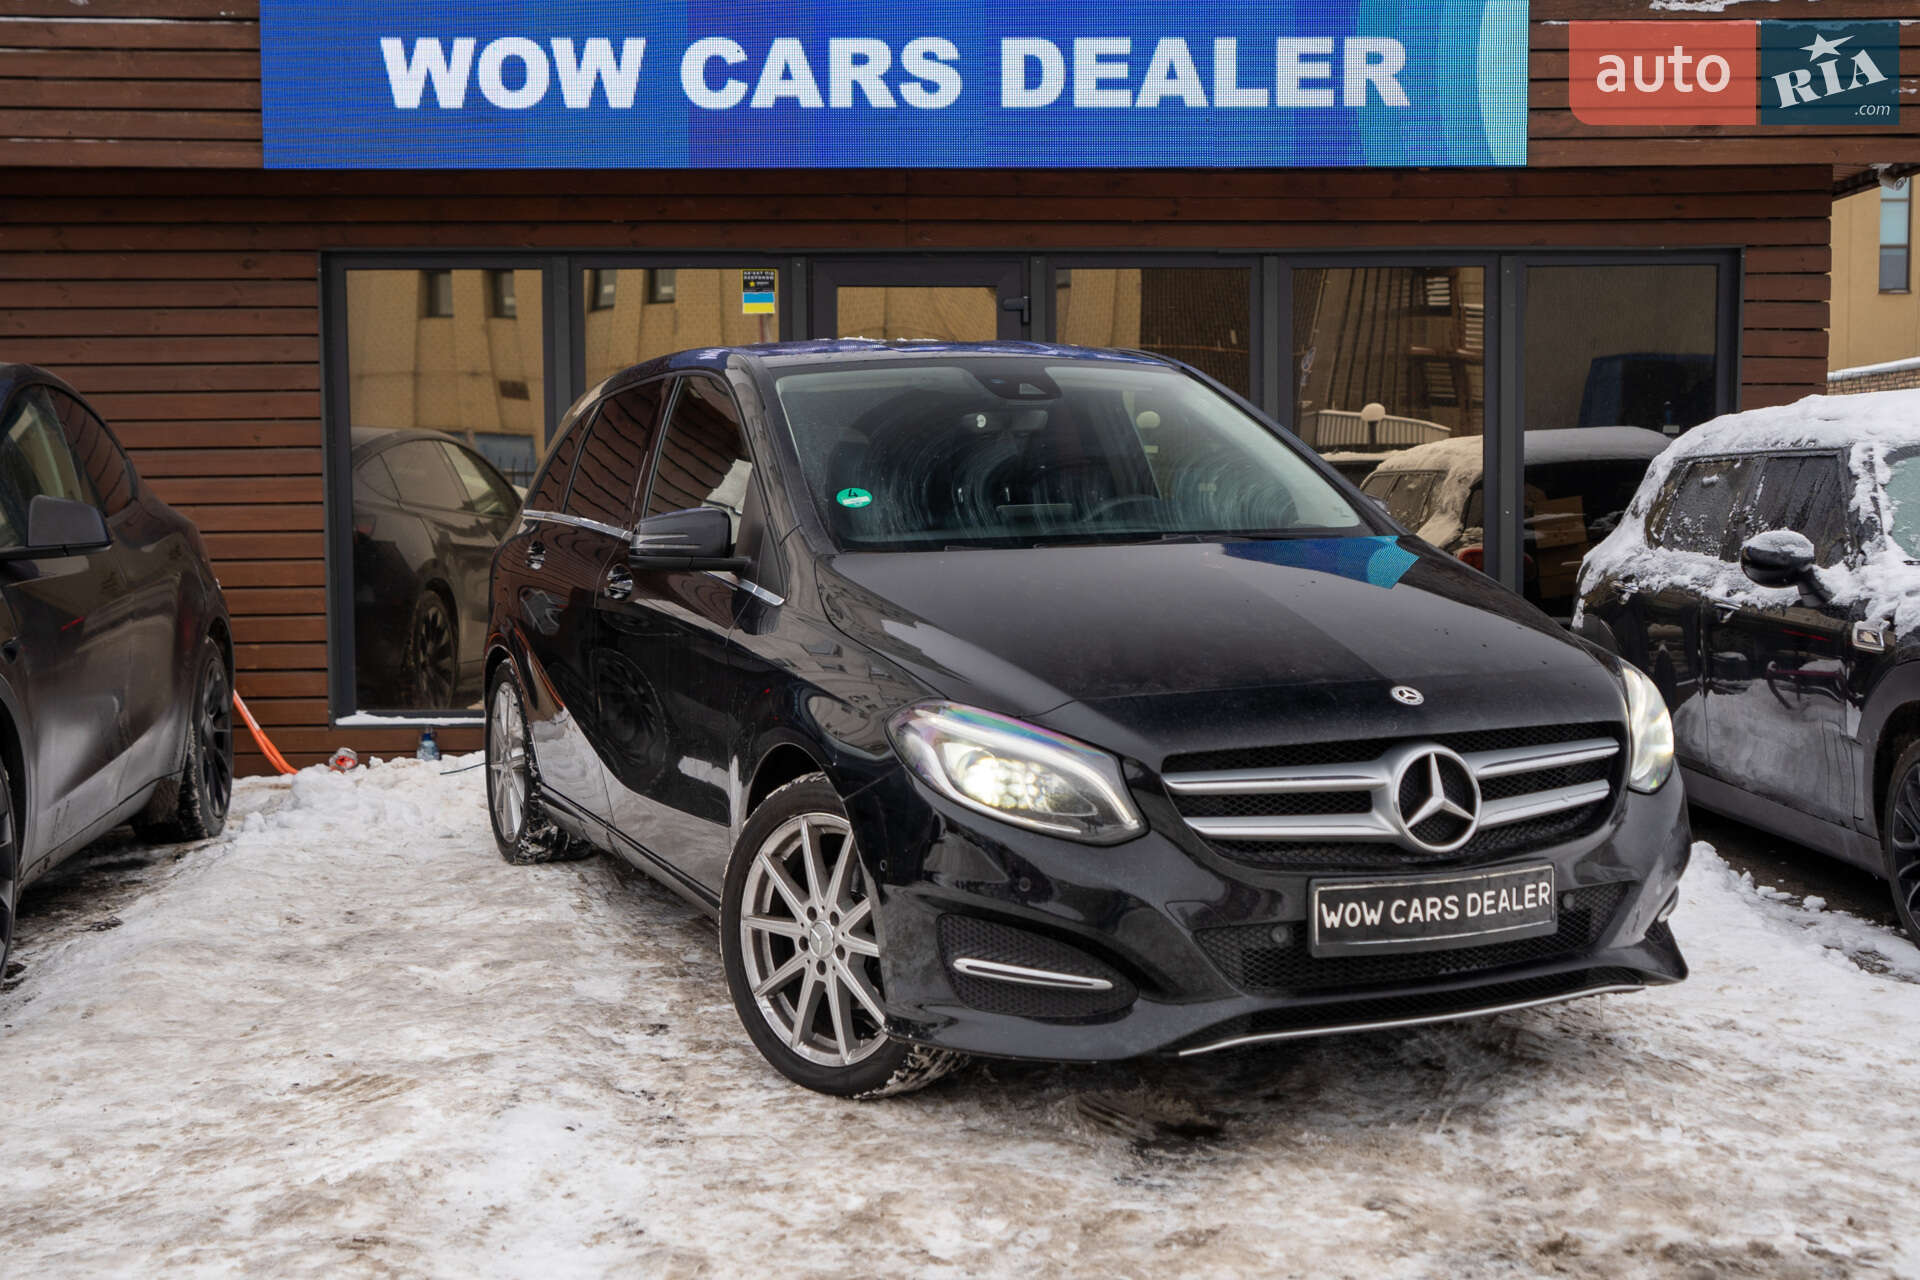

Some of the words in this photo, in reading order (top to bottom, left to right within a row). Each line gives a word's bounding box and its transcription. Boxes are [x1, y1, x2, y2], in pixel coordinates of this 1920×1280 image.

[380, 37, 646, 109] WOW
[681, 37, 962, 109] CARS
[1001, 37, 1411, 109] DEALER
[1320, 900, 1384, 929] WOW
[1390, 895, 1459, 924] CARS
[1466, 881, 1551, 918] DEALER
